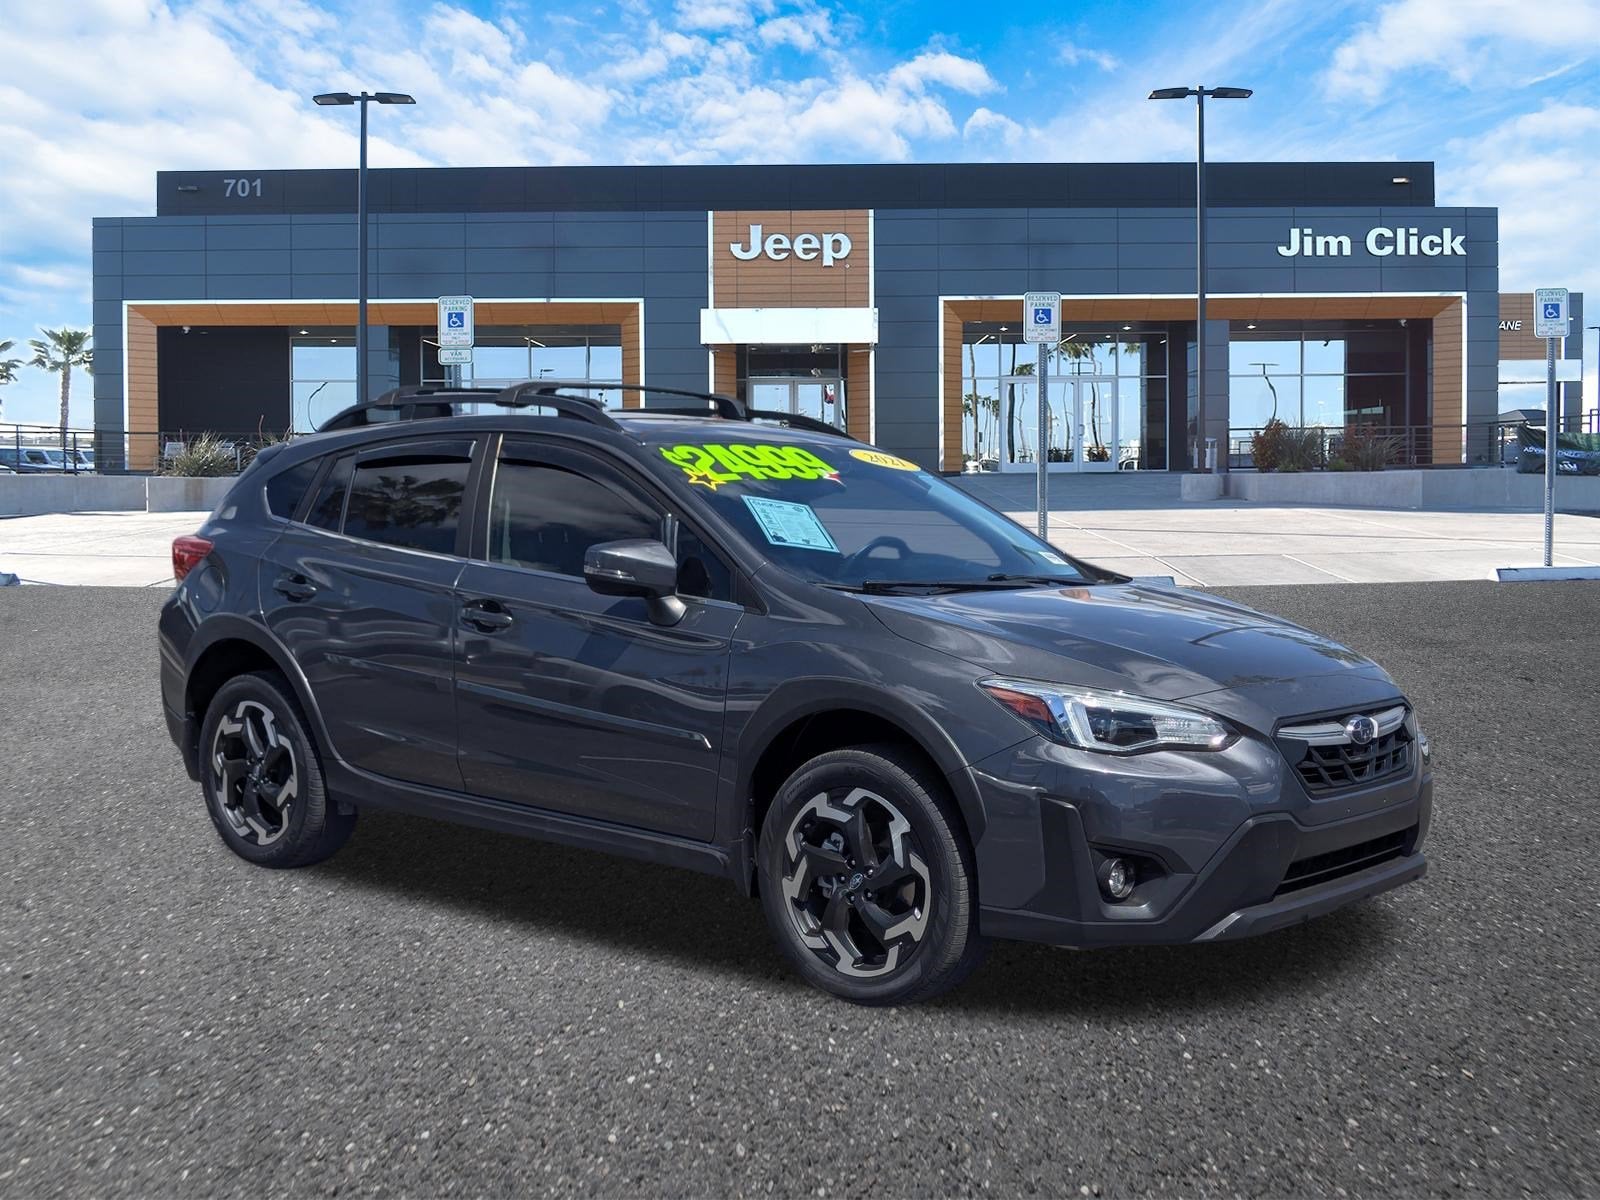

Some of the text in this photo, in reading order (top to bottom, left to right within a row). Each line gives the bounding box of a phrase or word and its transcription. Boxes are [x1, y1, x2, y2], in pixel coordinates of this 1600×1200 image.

[223, 178, 262, 197] 701
[730, 223, 852, 267] Jeep
[1277, 226, 1467, 257] Jim Click
[659, 444, 839, 481] $24999
[863, 452, 906, 467] 2021
